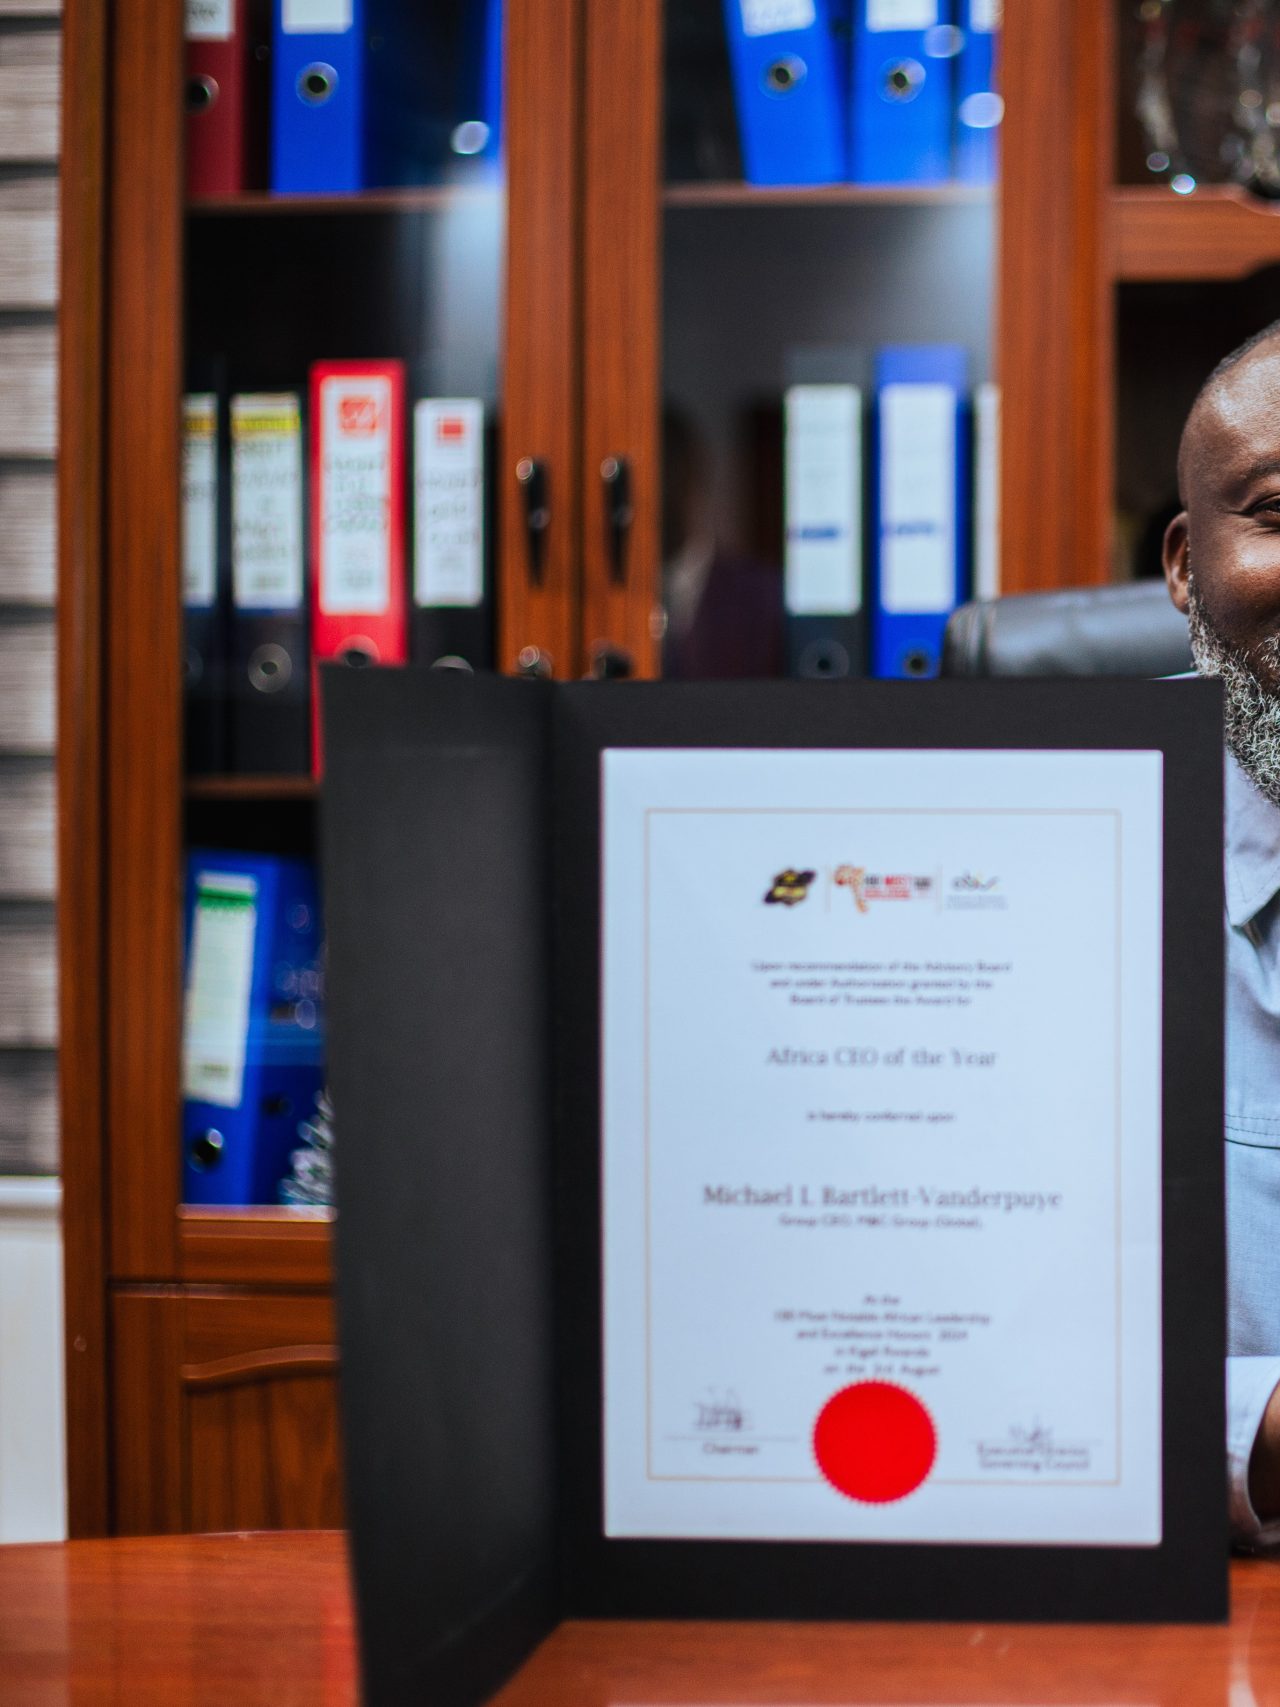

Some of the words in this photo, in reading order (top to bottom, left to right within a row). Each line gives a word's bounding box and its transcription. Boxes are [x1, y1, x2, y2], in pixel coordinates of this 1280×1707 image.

[766, 1046, 829, 1067] Africa
[833, 1046, 879, 1067] CEO
[883, 1046, 906, 1067] of
[911, 1046, 944, 1067] the
[951, 1046, 997, 1067] Year
[702, 1184, 794, 1206] Michael
[822, 1184, 1064, 1213] Bartlett-Vanderpuye
